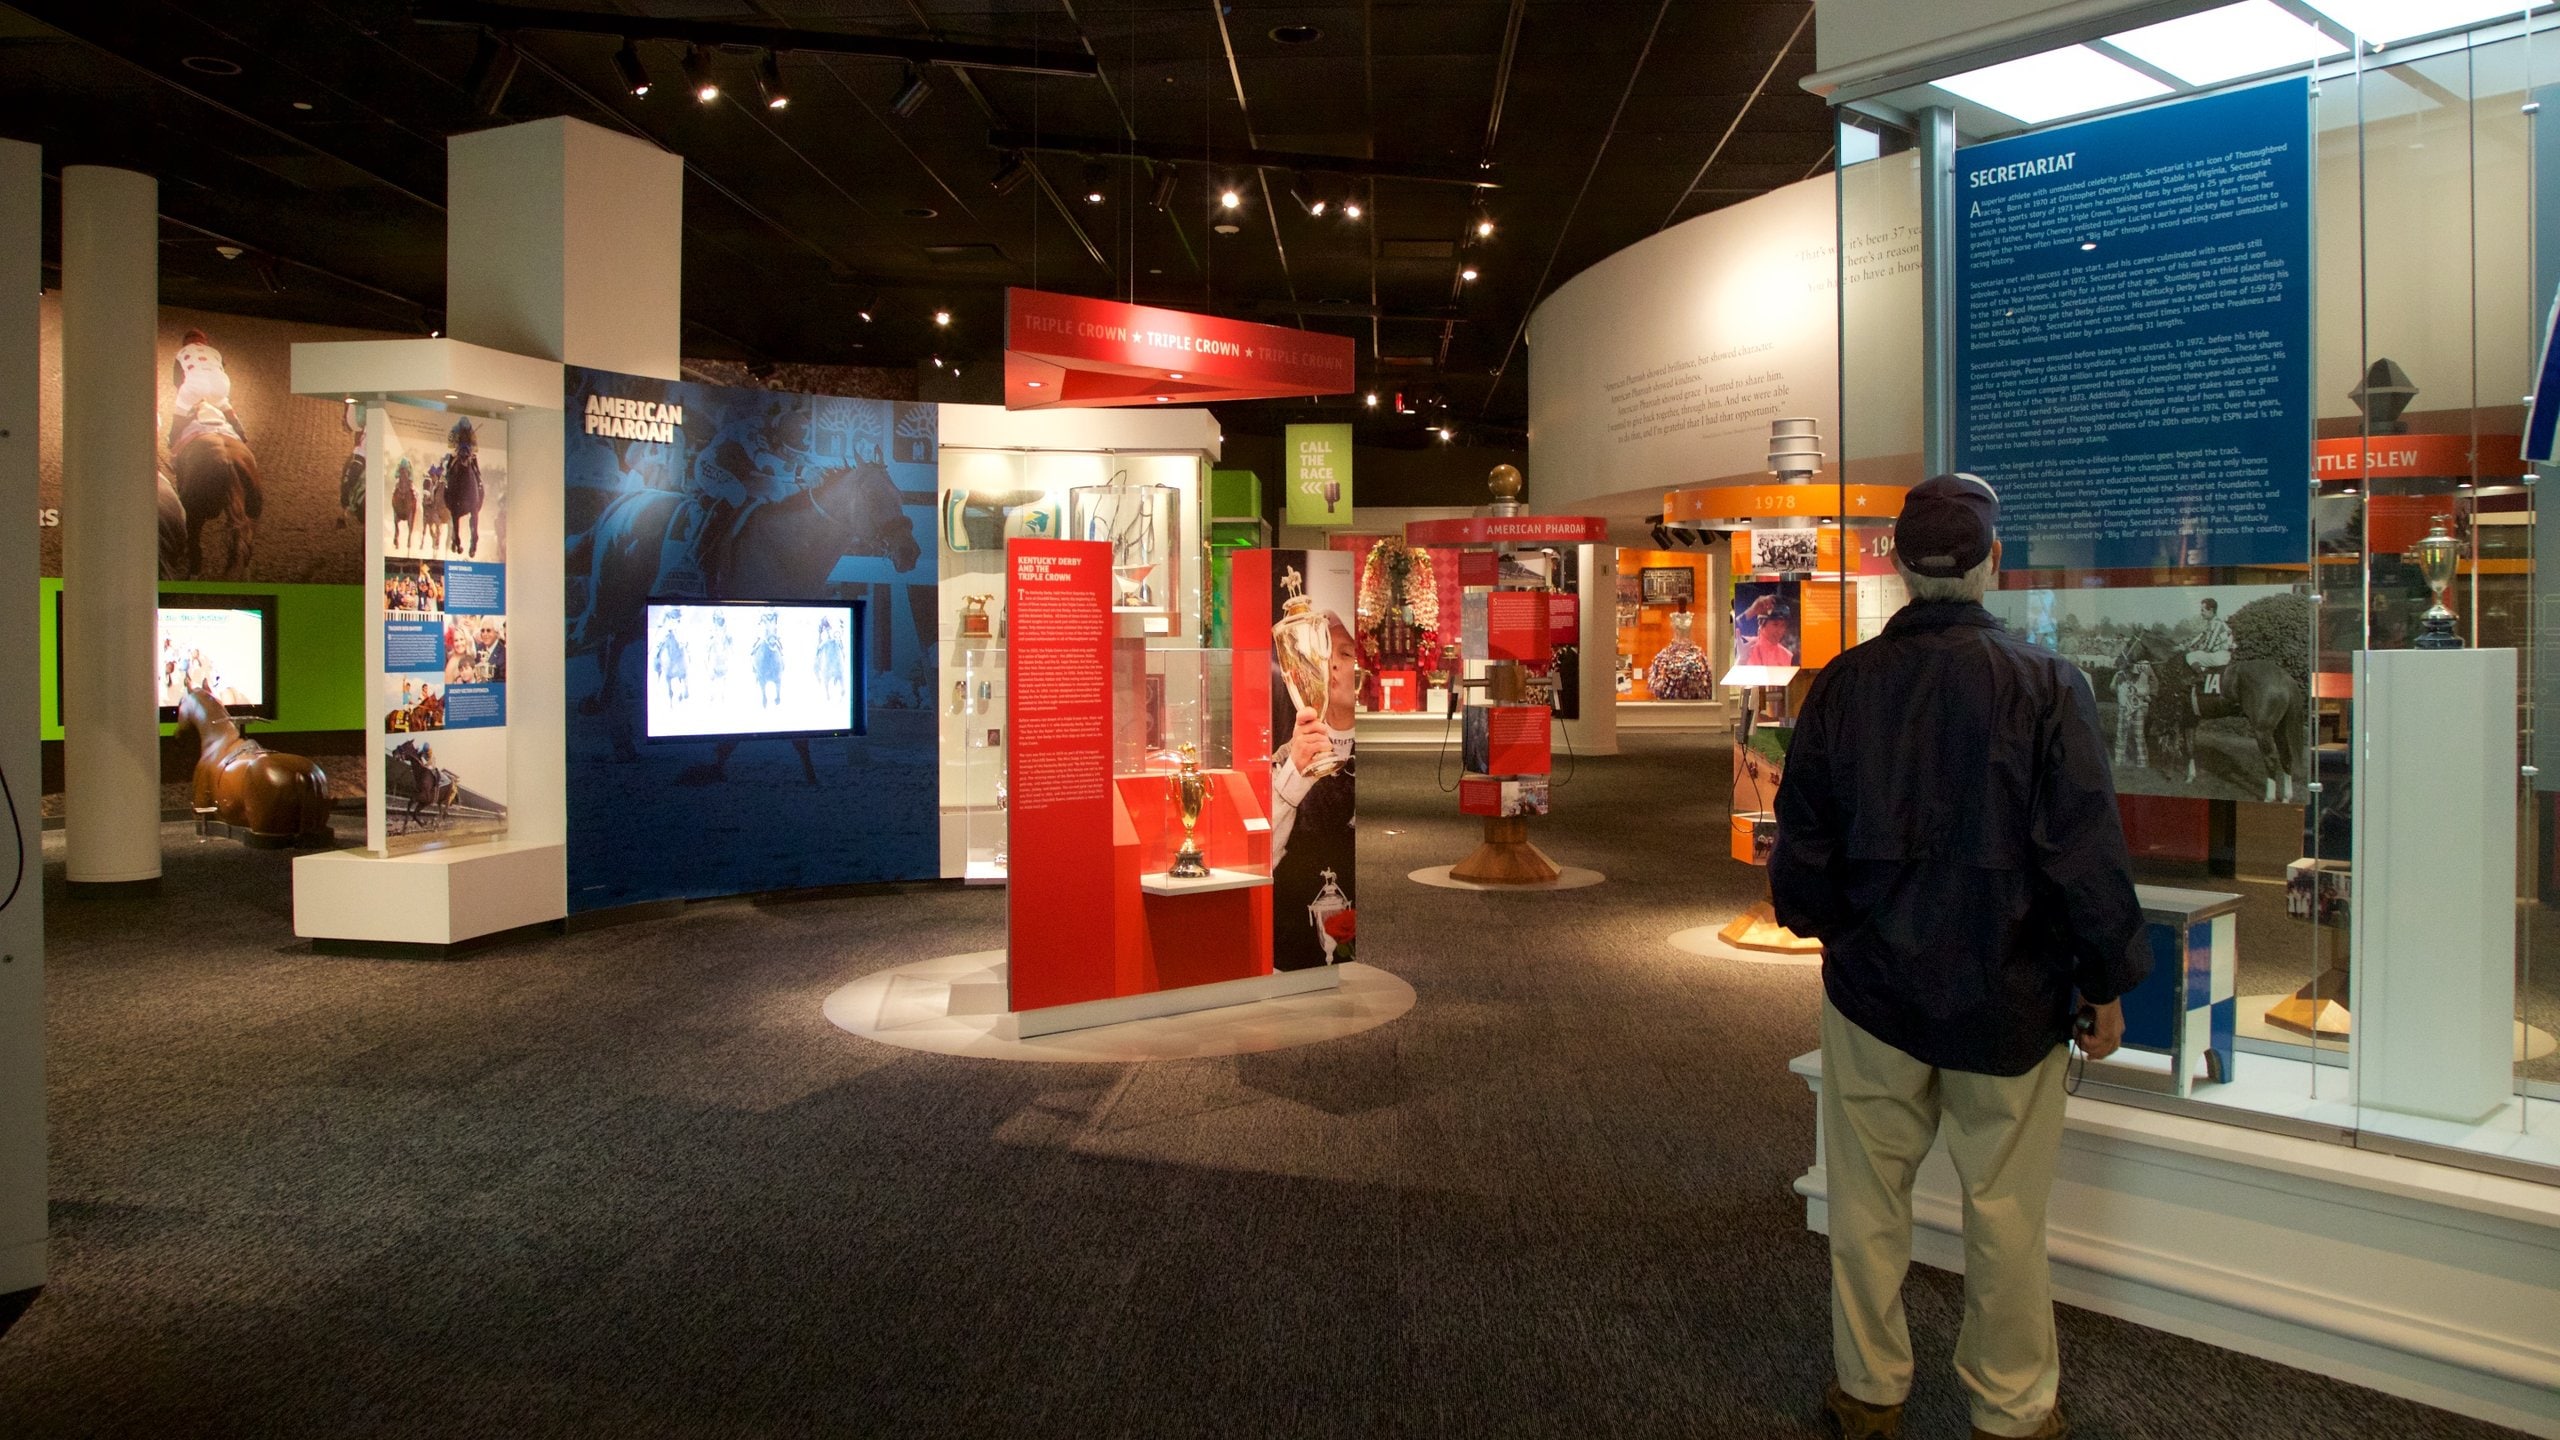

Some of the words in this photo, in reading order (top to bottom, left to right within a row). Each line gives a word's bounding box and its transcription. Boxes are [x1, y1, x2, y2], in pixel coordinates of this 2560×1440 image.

[1969, 152, 2076, 188] SECRETARIAT
[1866, 232, 1888, 246] been
[1890, 225, 1904, 241] 37
[1886, 244, 1919, 259] reason
[1850, 274, 1860, 284] to
[1863, 268, 1886, 281] have
[1024, 313, 1074, 336] TRIPLE
[1078, 322, 1127, 343] CROWN
[1146, 331, 1192, 352] TRIPLE
[1195, 338, 1241, 358] CROWN
[1258, 347, 1299, 367] TRIPLE
[1302, 352, 1344, 371] CROWN
[1710, 346, 1737, 362] showed
[1709, 378, 1734, 393] wanted
[1745, 374, 1765, 386] share
[1773, 384, 1790, 398] able
[584, 394, 682, 425] AMERICAN
[584, 415, 674, 444] PHAROAH
[1300, 440, 1332, 454] CALL
[1300, 454, 1325, 468] THE
[2366, 449, 2418, 468] SLEW
[1300, 467, 1334, 481] RACE
[1755, 495, 1797, 510] 1978
[1486, 523, 1542, 536] AMERICAN
[1545, 522, 1586, 534] PHAROAH
[1017, 556, 1057, 566] KENTUCKY
[1058, 557, 1082, 567] DERBY
[1017, 564, 1035, 573] AND
[1036, 564, 1050, 573] THE
[1017, 572, 1043, 582] TRIPLE
[1044, 573, 1071, 582] CROWN
